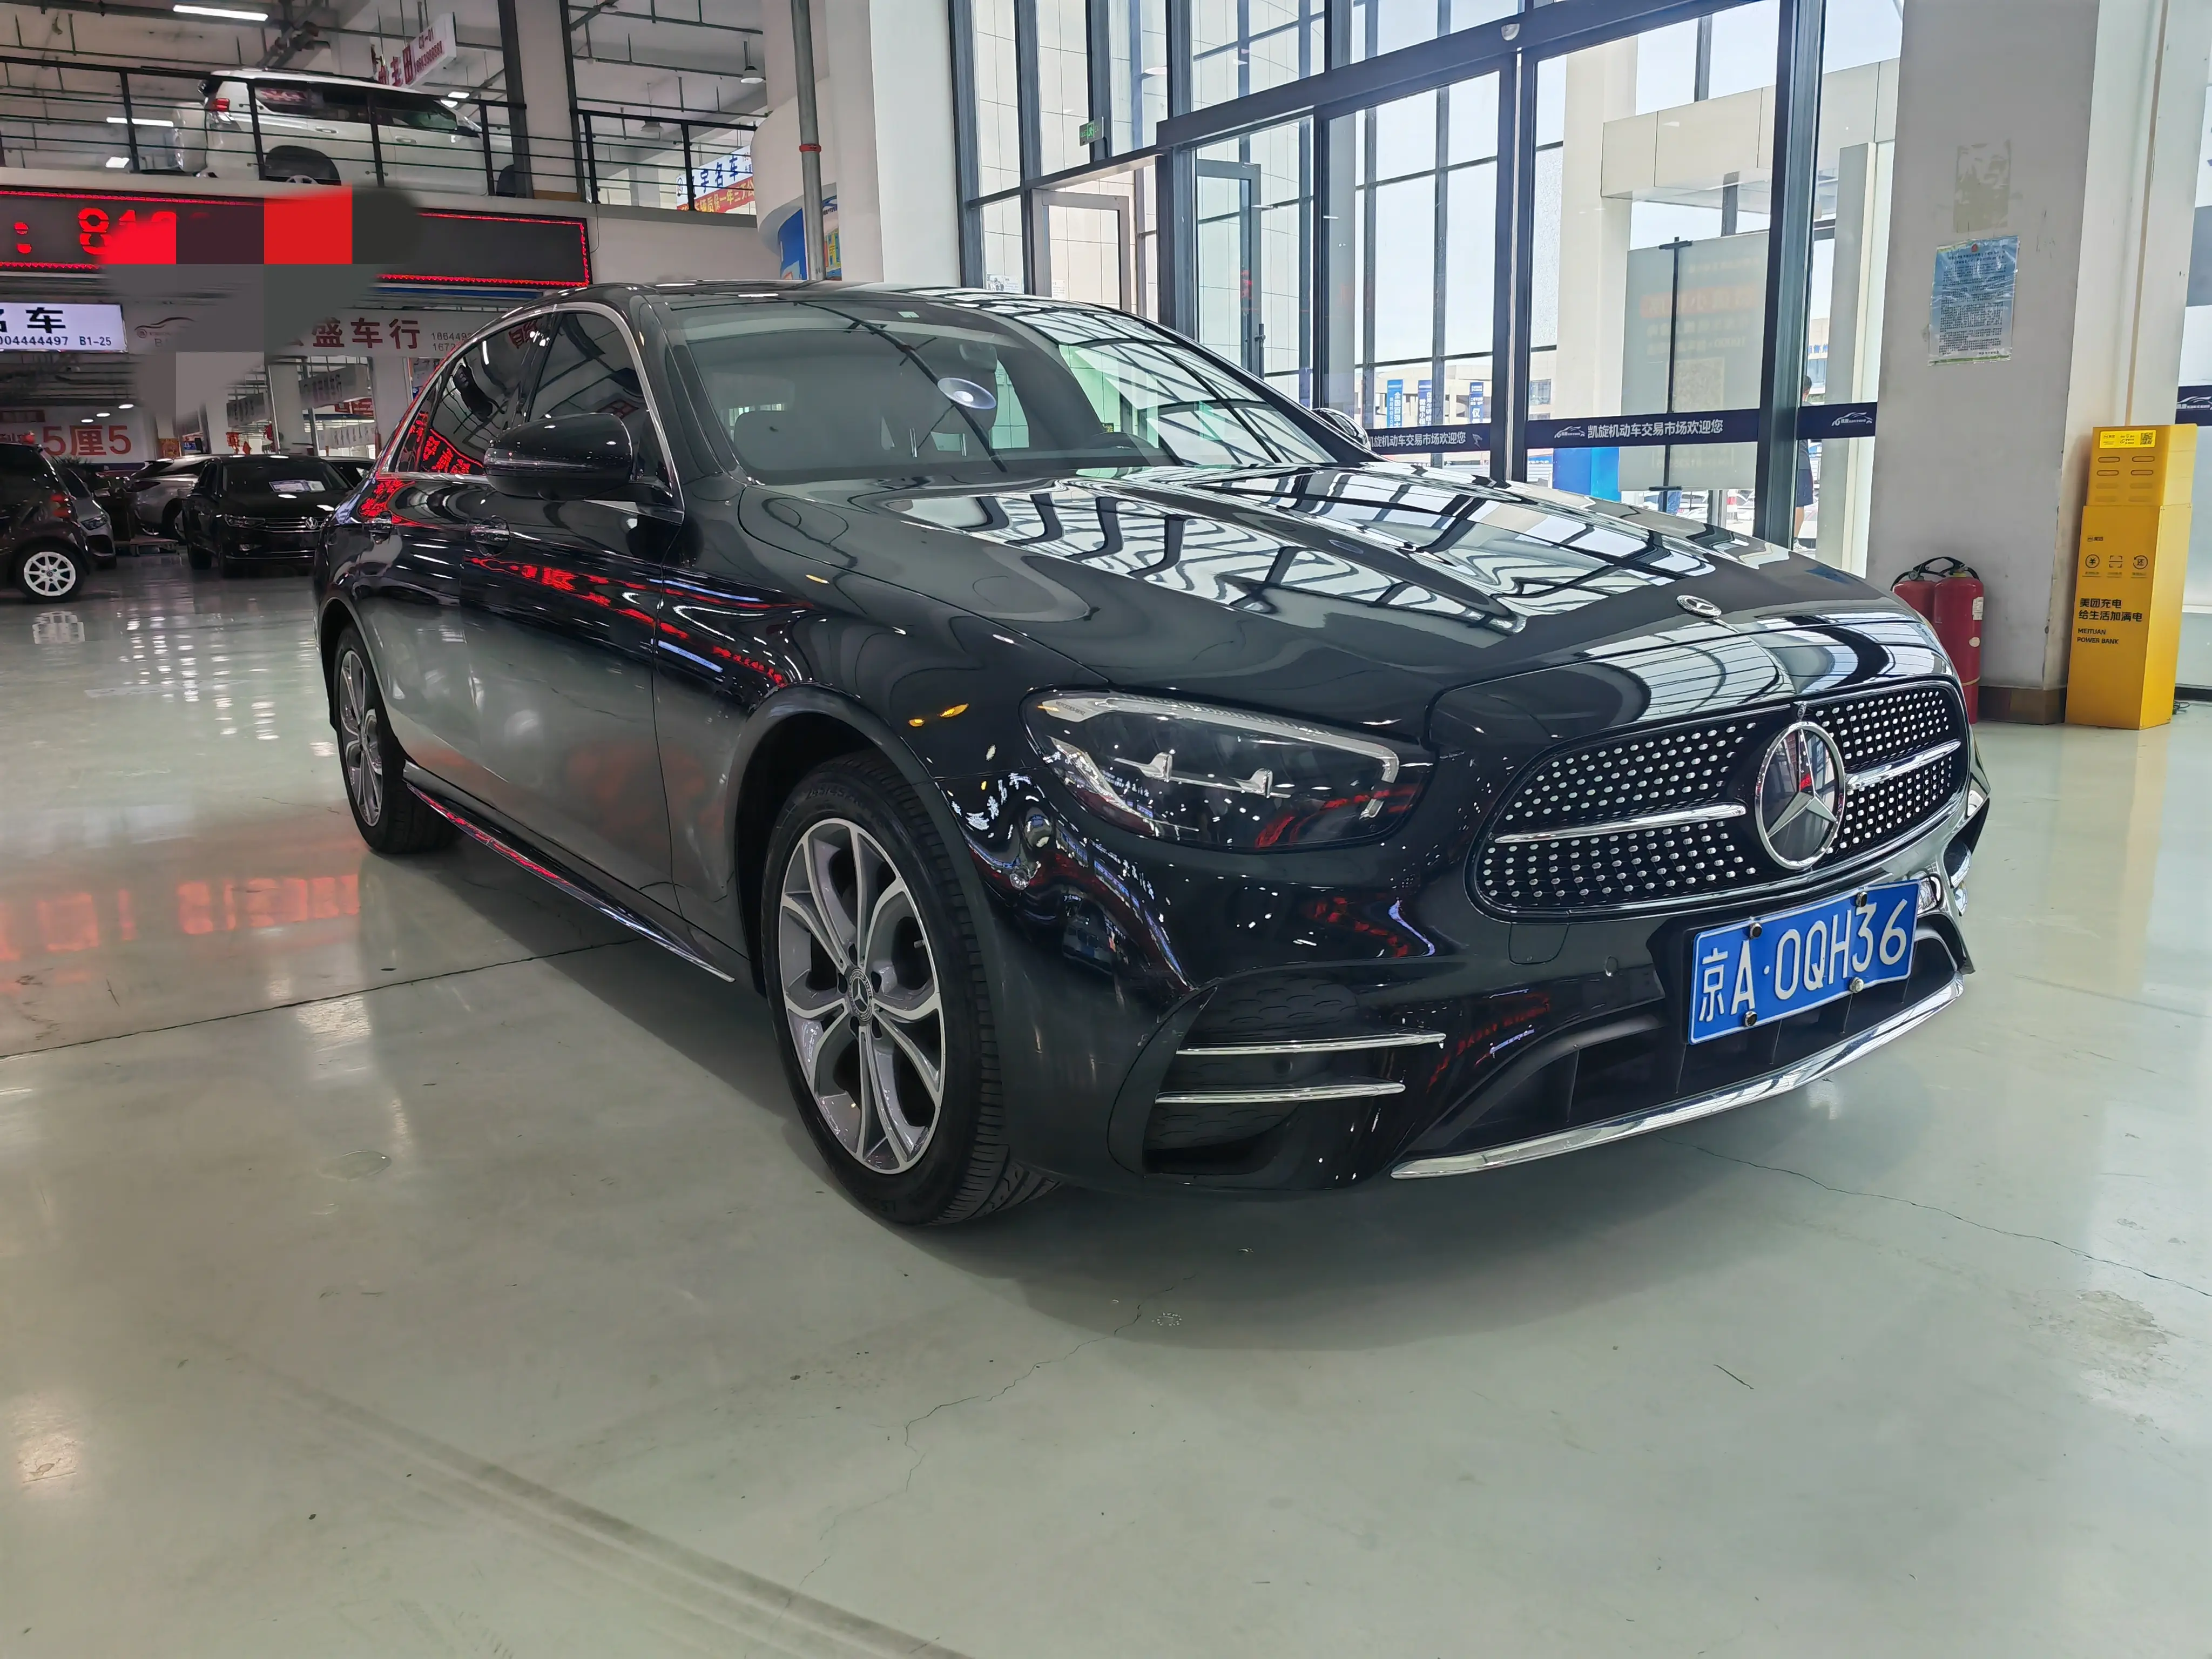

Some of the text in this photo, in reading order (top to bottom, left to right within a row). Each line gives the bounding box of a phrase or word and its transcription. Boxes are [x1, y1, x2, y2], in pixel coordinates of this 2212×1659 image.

[692, 156, 739, 193] 宇名车
[79, 335, 111, 346] B1-25
[294, 317, 420, 349] 盛车行
[1587, 419, 1723, 439] 凯旋机动车交易市场欢迎您
[2080, 598, 2122, 609] 美团充电
[2079, 610, 2142, 622] 给生活加满电
